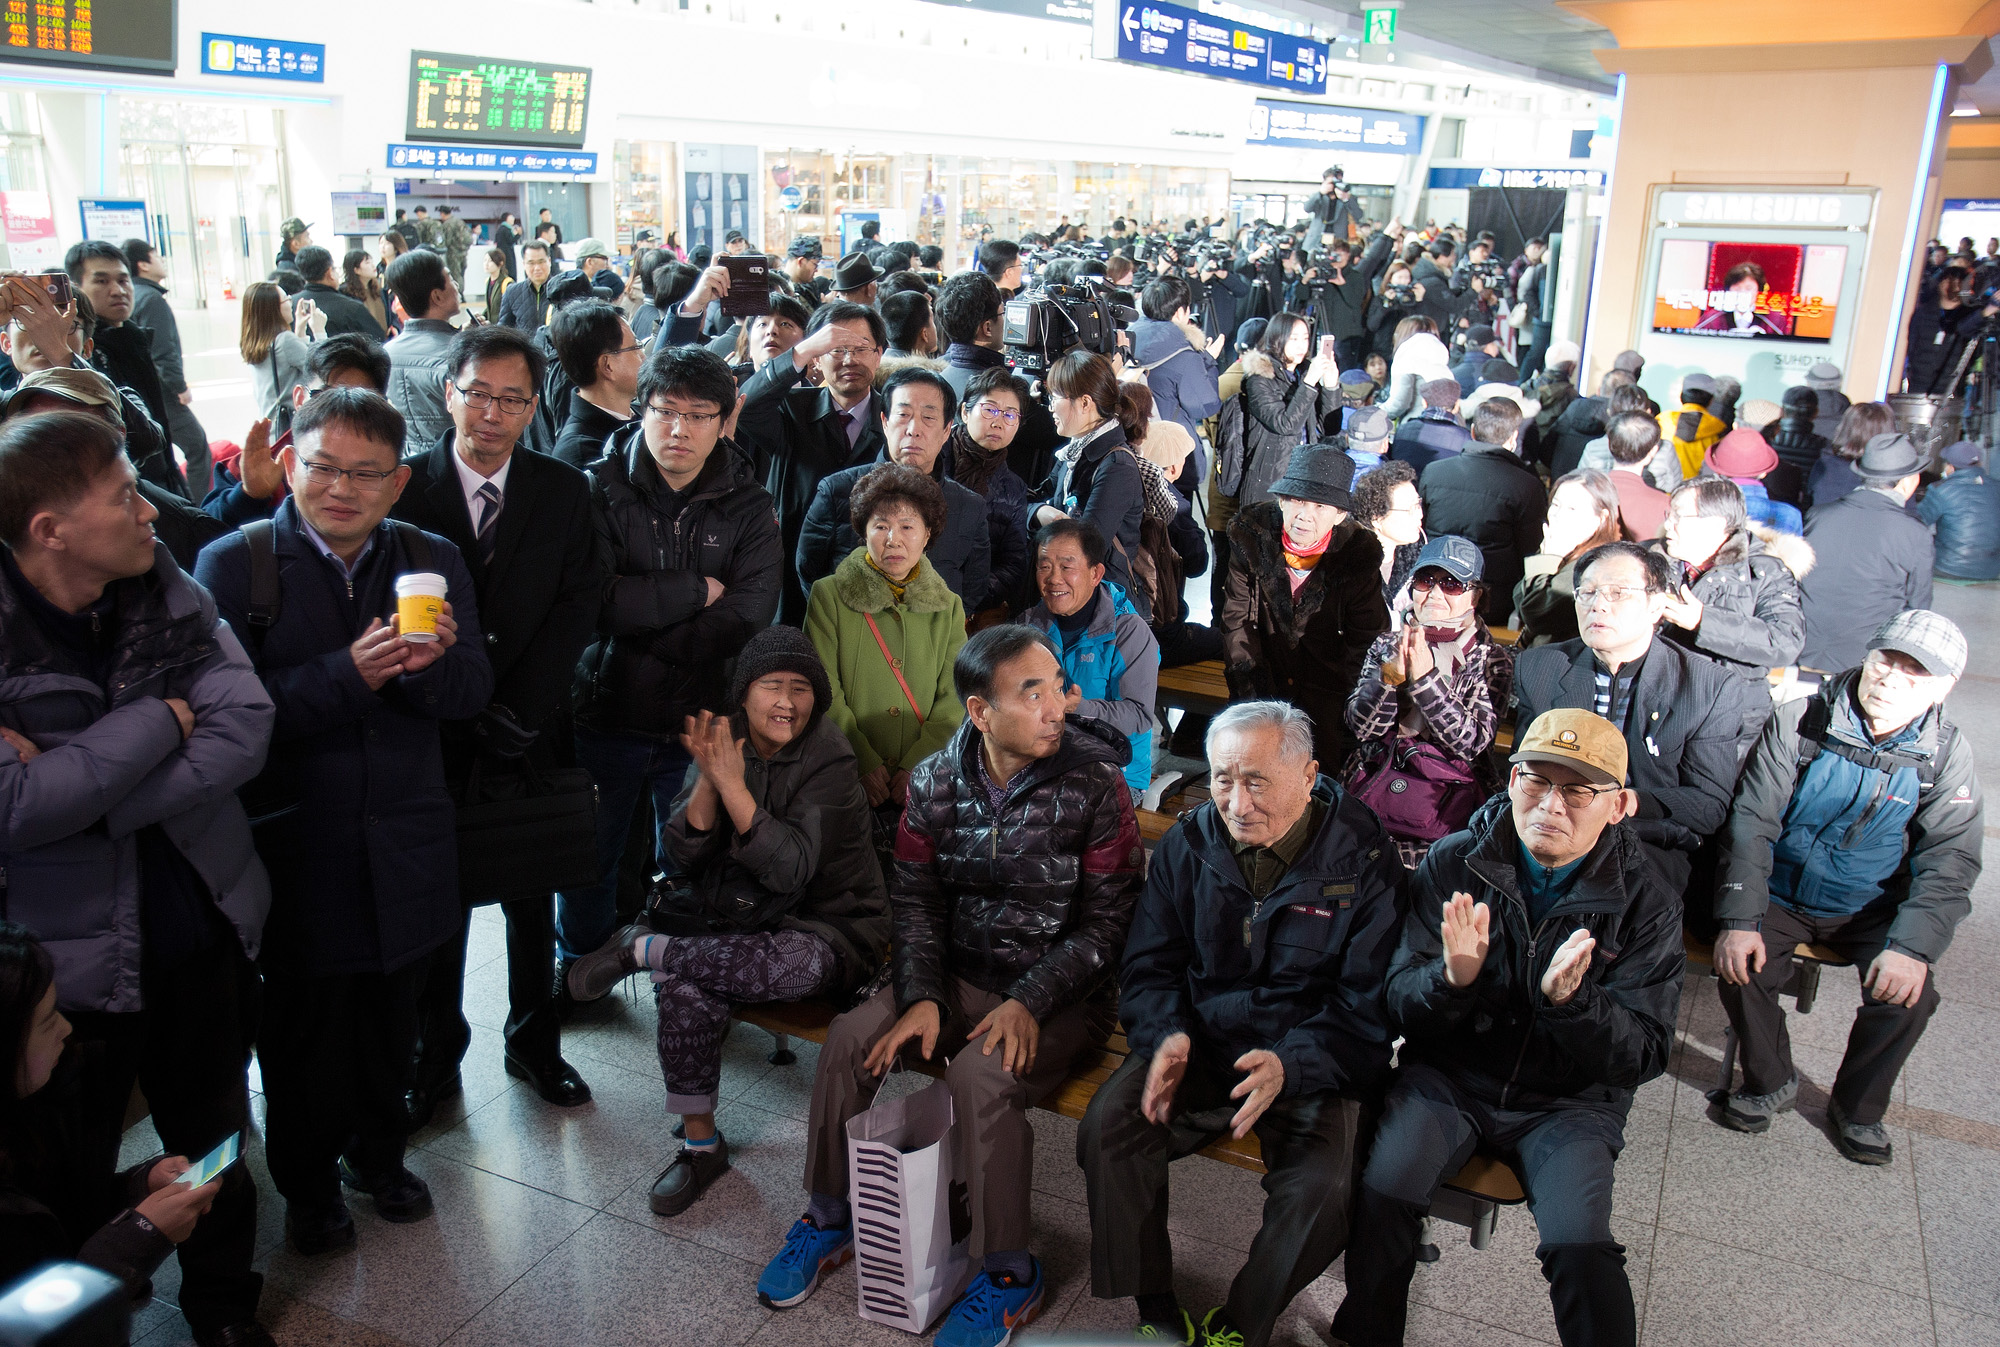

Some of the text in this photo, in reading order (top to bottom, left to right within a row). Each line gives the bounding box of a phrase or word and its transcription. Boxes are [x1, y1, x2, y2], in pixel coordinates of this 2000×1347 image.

[236, 44, 262, 65] 타는
[267, 47, 280, 66] 곳
[1685, 195, 1841, 222] SAMSUNG
